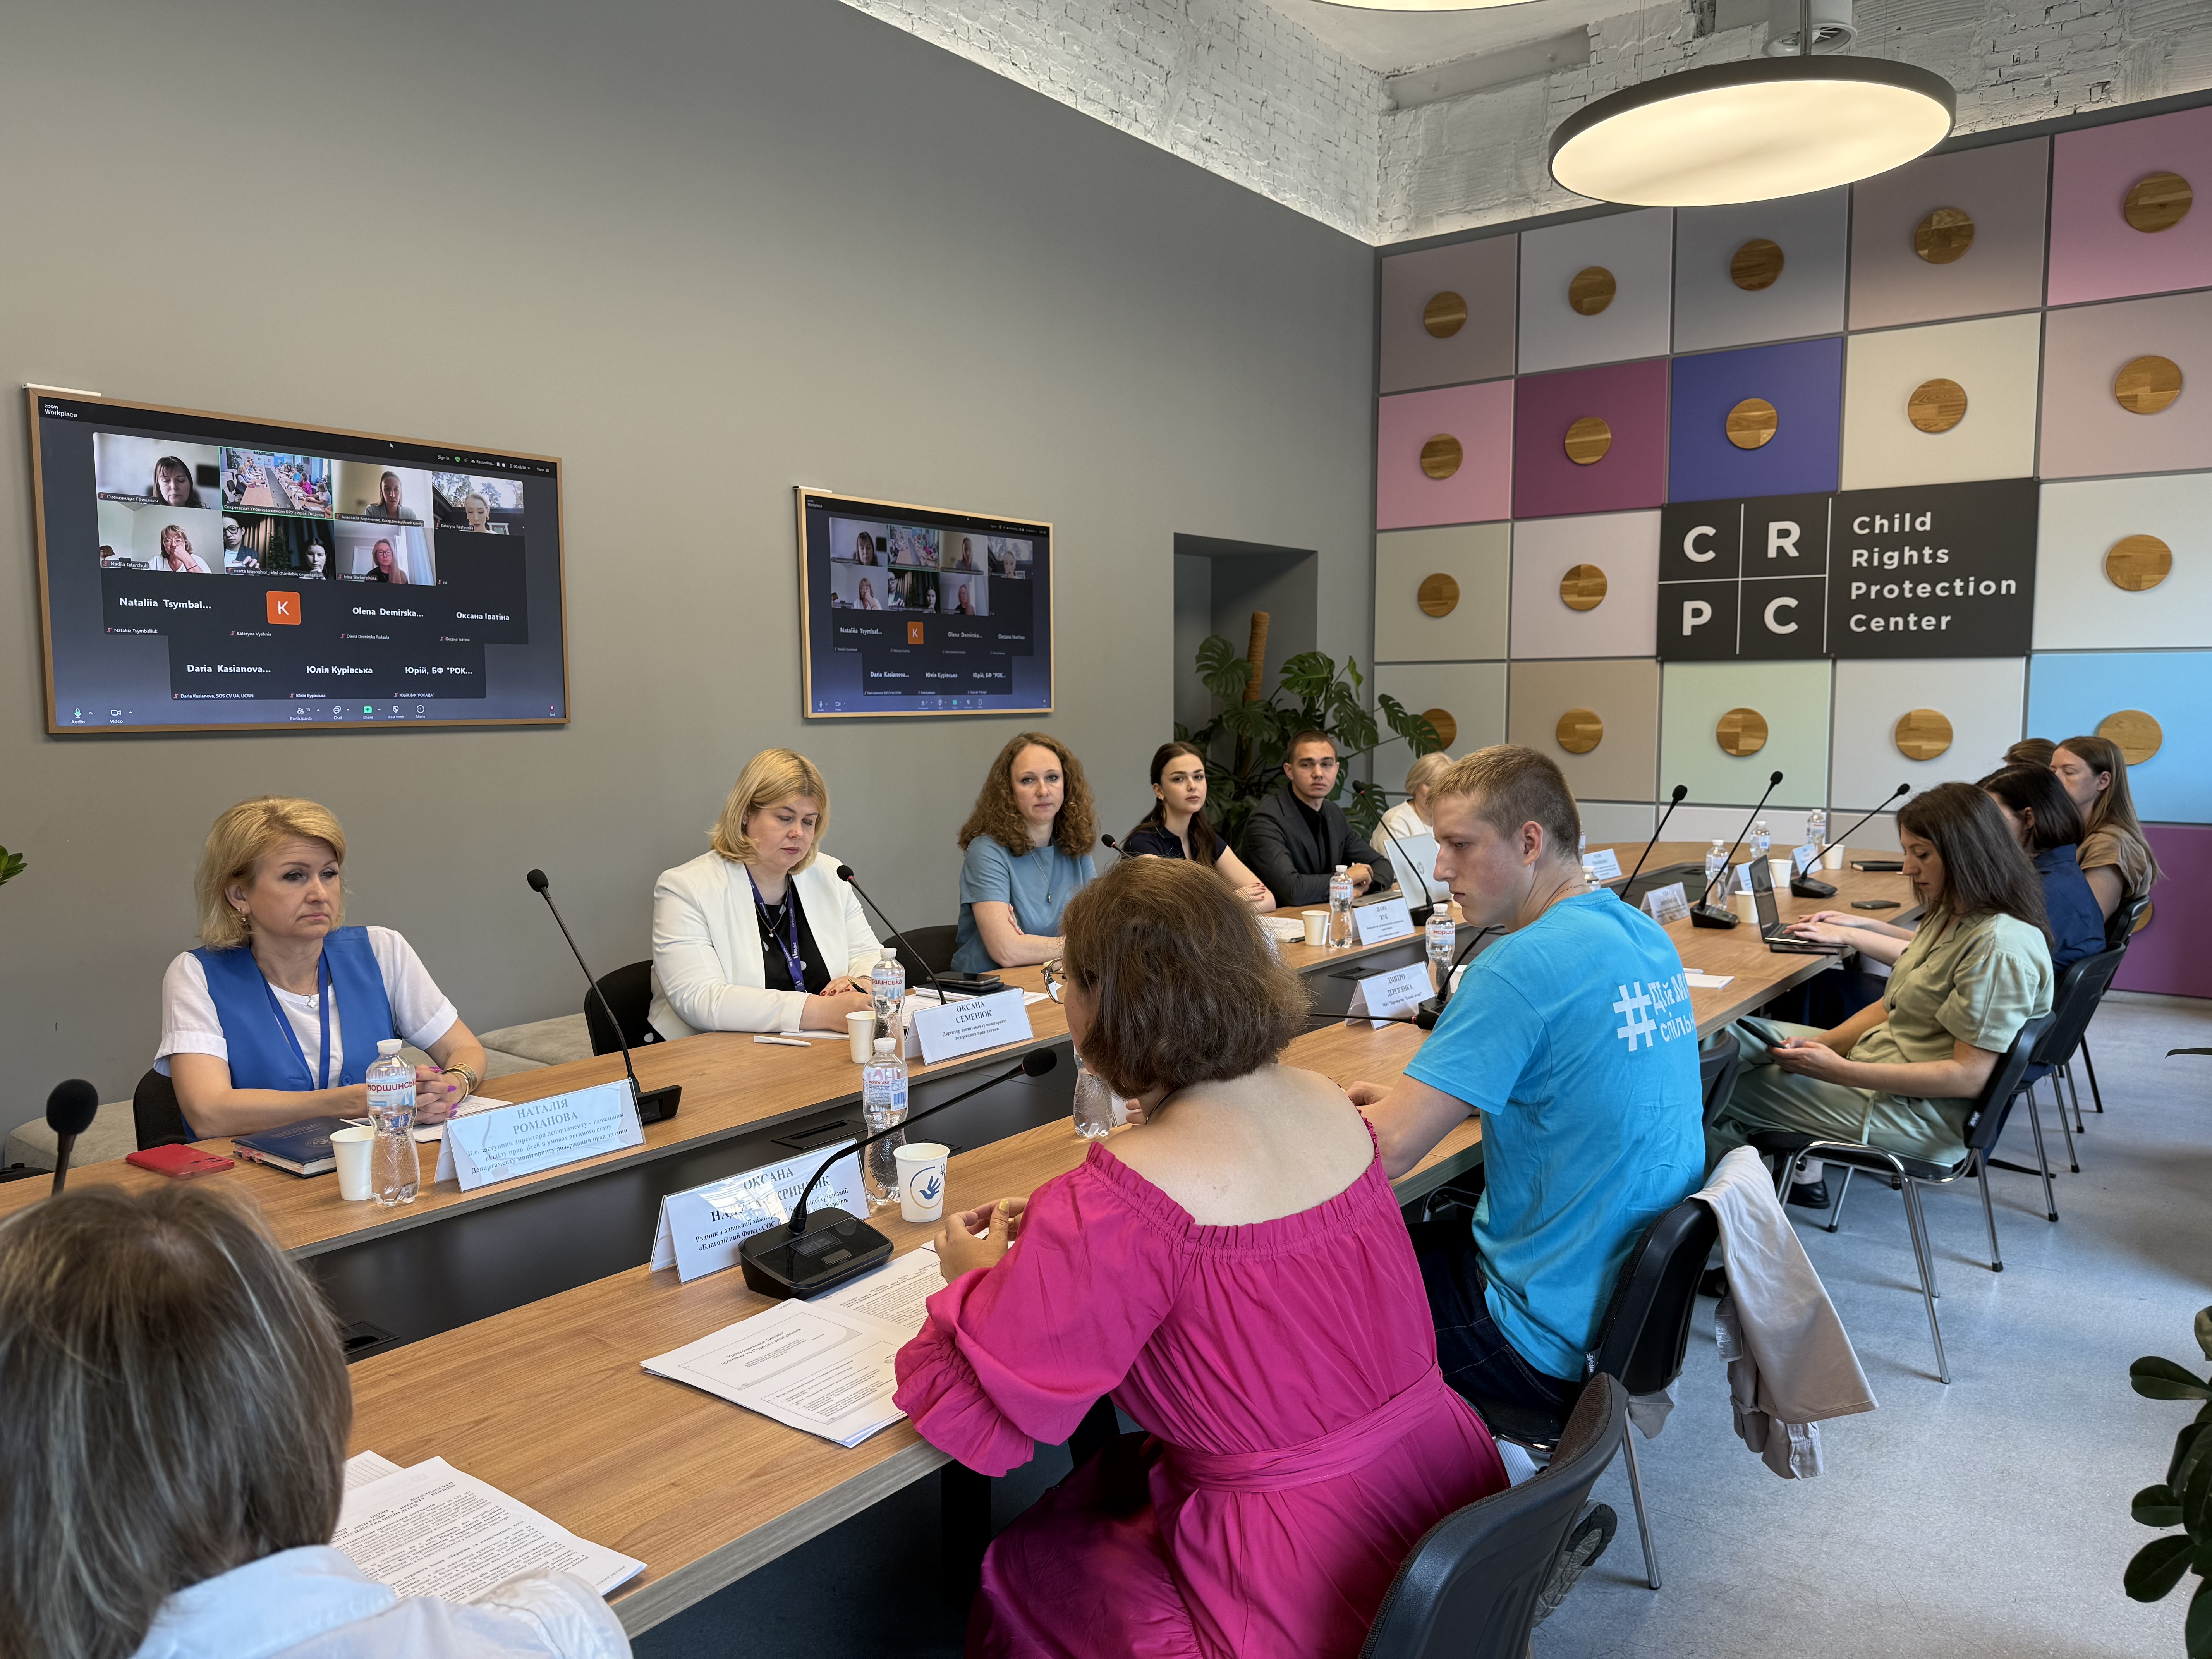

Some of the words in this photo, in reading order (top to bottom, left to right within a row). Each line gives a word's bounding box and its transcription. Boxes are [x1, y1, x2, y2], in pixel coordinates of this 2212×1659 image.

[45, 409, 77, 417] Workplace
[1852, 512, 1932, 535] Child
[1683, 526, 1717, 563] C
[1767, 521, 1800, 558] R
[1851, 546, 1949, 570] Rights
[1850, 577, 2016, 600] Protection
[119, 598, 158, 608] Nataliia
[163, 599, 212, 610] Tsymbal...
[277, 601, 289, 615] K
[352, 607, 376, 615] Olena
[380, 608, 424, 617] Demirska...
[485, 613, 510, 621] Іватіна
[1682, 600, 1712, 636] P
[1764, 596, 1799, 634] C
[1849, 613, 1952, 633] Center
[913, 629, 918, 637] K
[187, 664, 212, 673] Daria
[217, 665, 271, 673] Kasianova...
[331, 666, 373, 675] Курівська
[405, 667, 429, 676] Юрій,
[1388, 974, 1405, 985] ДМИТРО
[956, 1001, 985, 1012] ОКСАНА
[956, 1010, 992, 1023] СЕМЕНЮК
[961, 1024, 985, 1032] департаменту
[517, 1099, 568, 1119] НАТАЛІЯ
[482, 1141, 513, 1153] заступник
[514, 1133, 546, 1146] директора
[548, 1122, 587, 1137] департаменту
[594, 1113, 624, 1125] начальник
[513, 1112, 579, 1134] РОМАНОВА
[509, 1147, 524, 1155] прав
[525, 1142, 540, 1151] дітей
[547, 1136, 568, 1146] умовах
[471, 1158, 515, 1174] Департаменту
[517, 1147, 555, 1161] моніторингу
[557, 1138, 591, 1152] додержання
[743, 1167, 794, 1190] ОКСАНА
[696, 1231, 718, 1242] Радник
[724, 1219, 752, 1233] адвокації
[821, 1188, 848, 1202] організації
[699, 1233, 740, 1251] «Благодійний
[741, 1228, 757, 1237] Фонд
[759, 1221, 776, 1232] «СОС
[351, 1514, 387, 1529] ПРОГРАМИ
[398, 1497, 427, 1509] ПРОЄКТУ
[429, 1484, 459, 1496] ПОРЯДКУ
[369, 1510, 390, 1518] ЩОДО
[408, 1482, 455, 1501] МОЖЛИВОСТЕЙ
[340, 1520, 384, 1538] НАСИЛЬСТВА
[381, 1512, 402, 1521] ЩОДО
[399, 1504, 420, 1513] ДІТЕЙ
